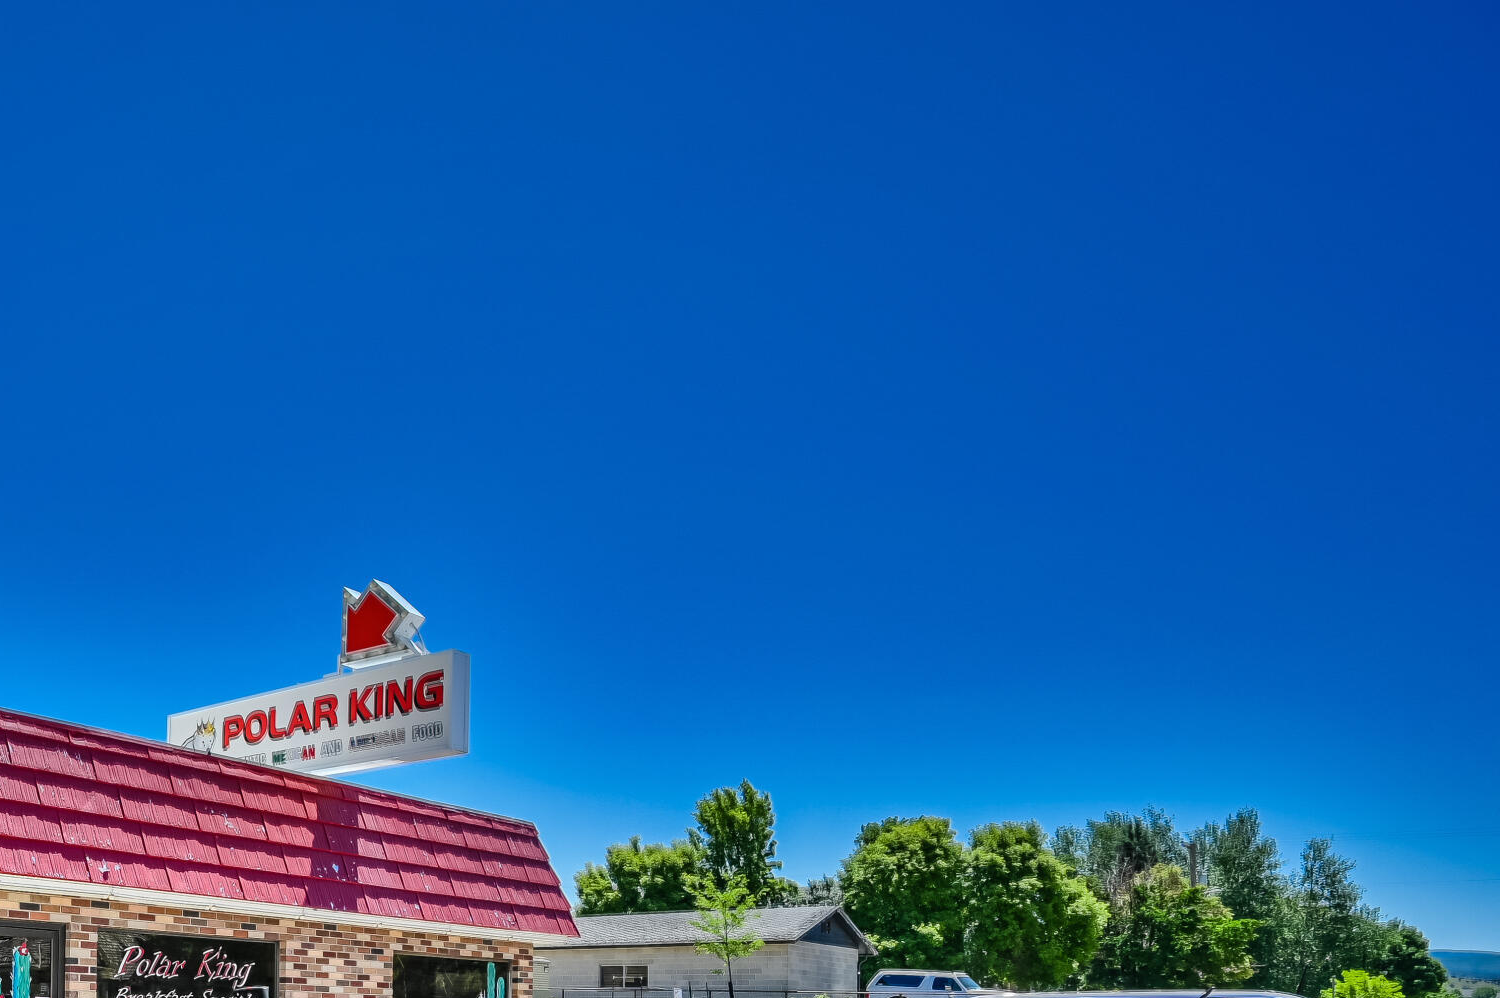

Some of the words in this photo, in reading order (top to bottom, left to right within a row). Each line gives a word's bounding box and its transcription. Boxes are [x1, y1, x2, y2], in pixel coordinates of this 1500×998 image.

[222, 694, 339, 751] POLAR
[348, 669, 445, 726] KING
[272, 744, 316, 766] MEXICAN
[320, 738, 343, 758] AND
[411, 721, 444, 743] FOOD
[113, 945, 186, 979] Polar
[193, 945, 256, 989] King
